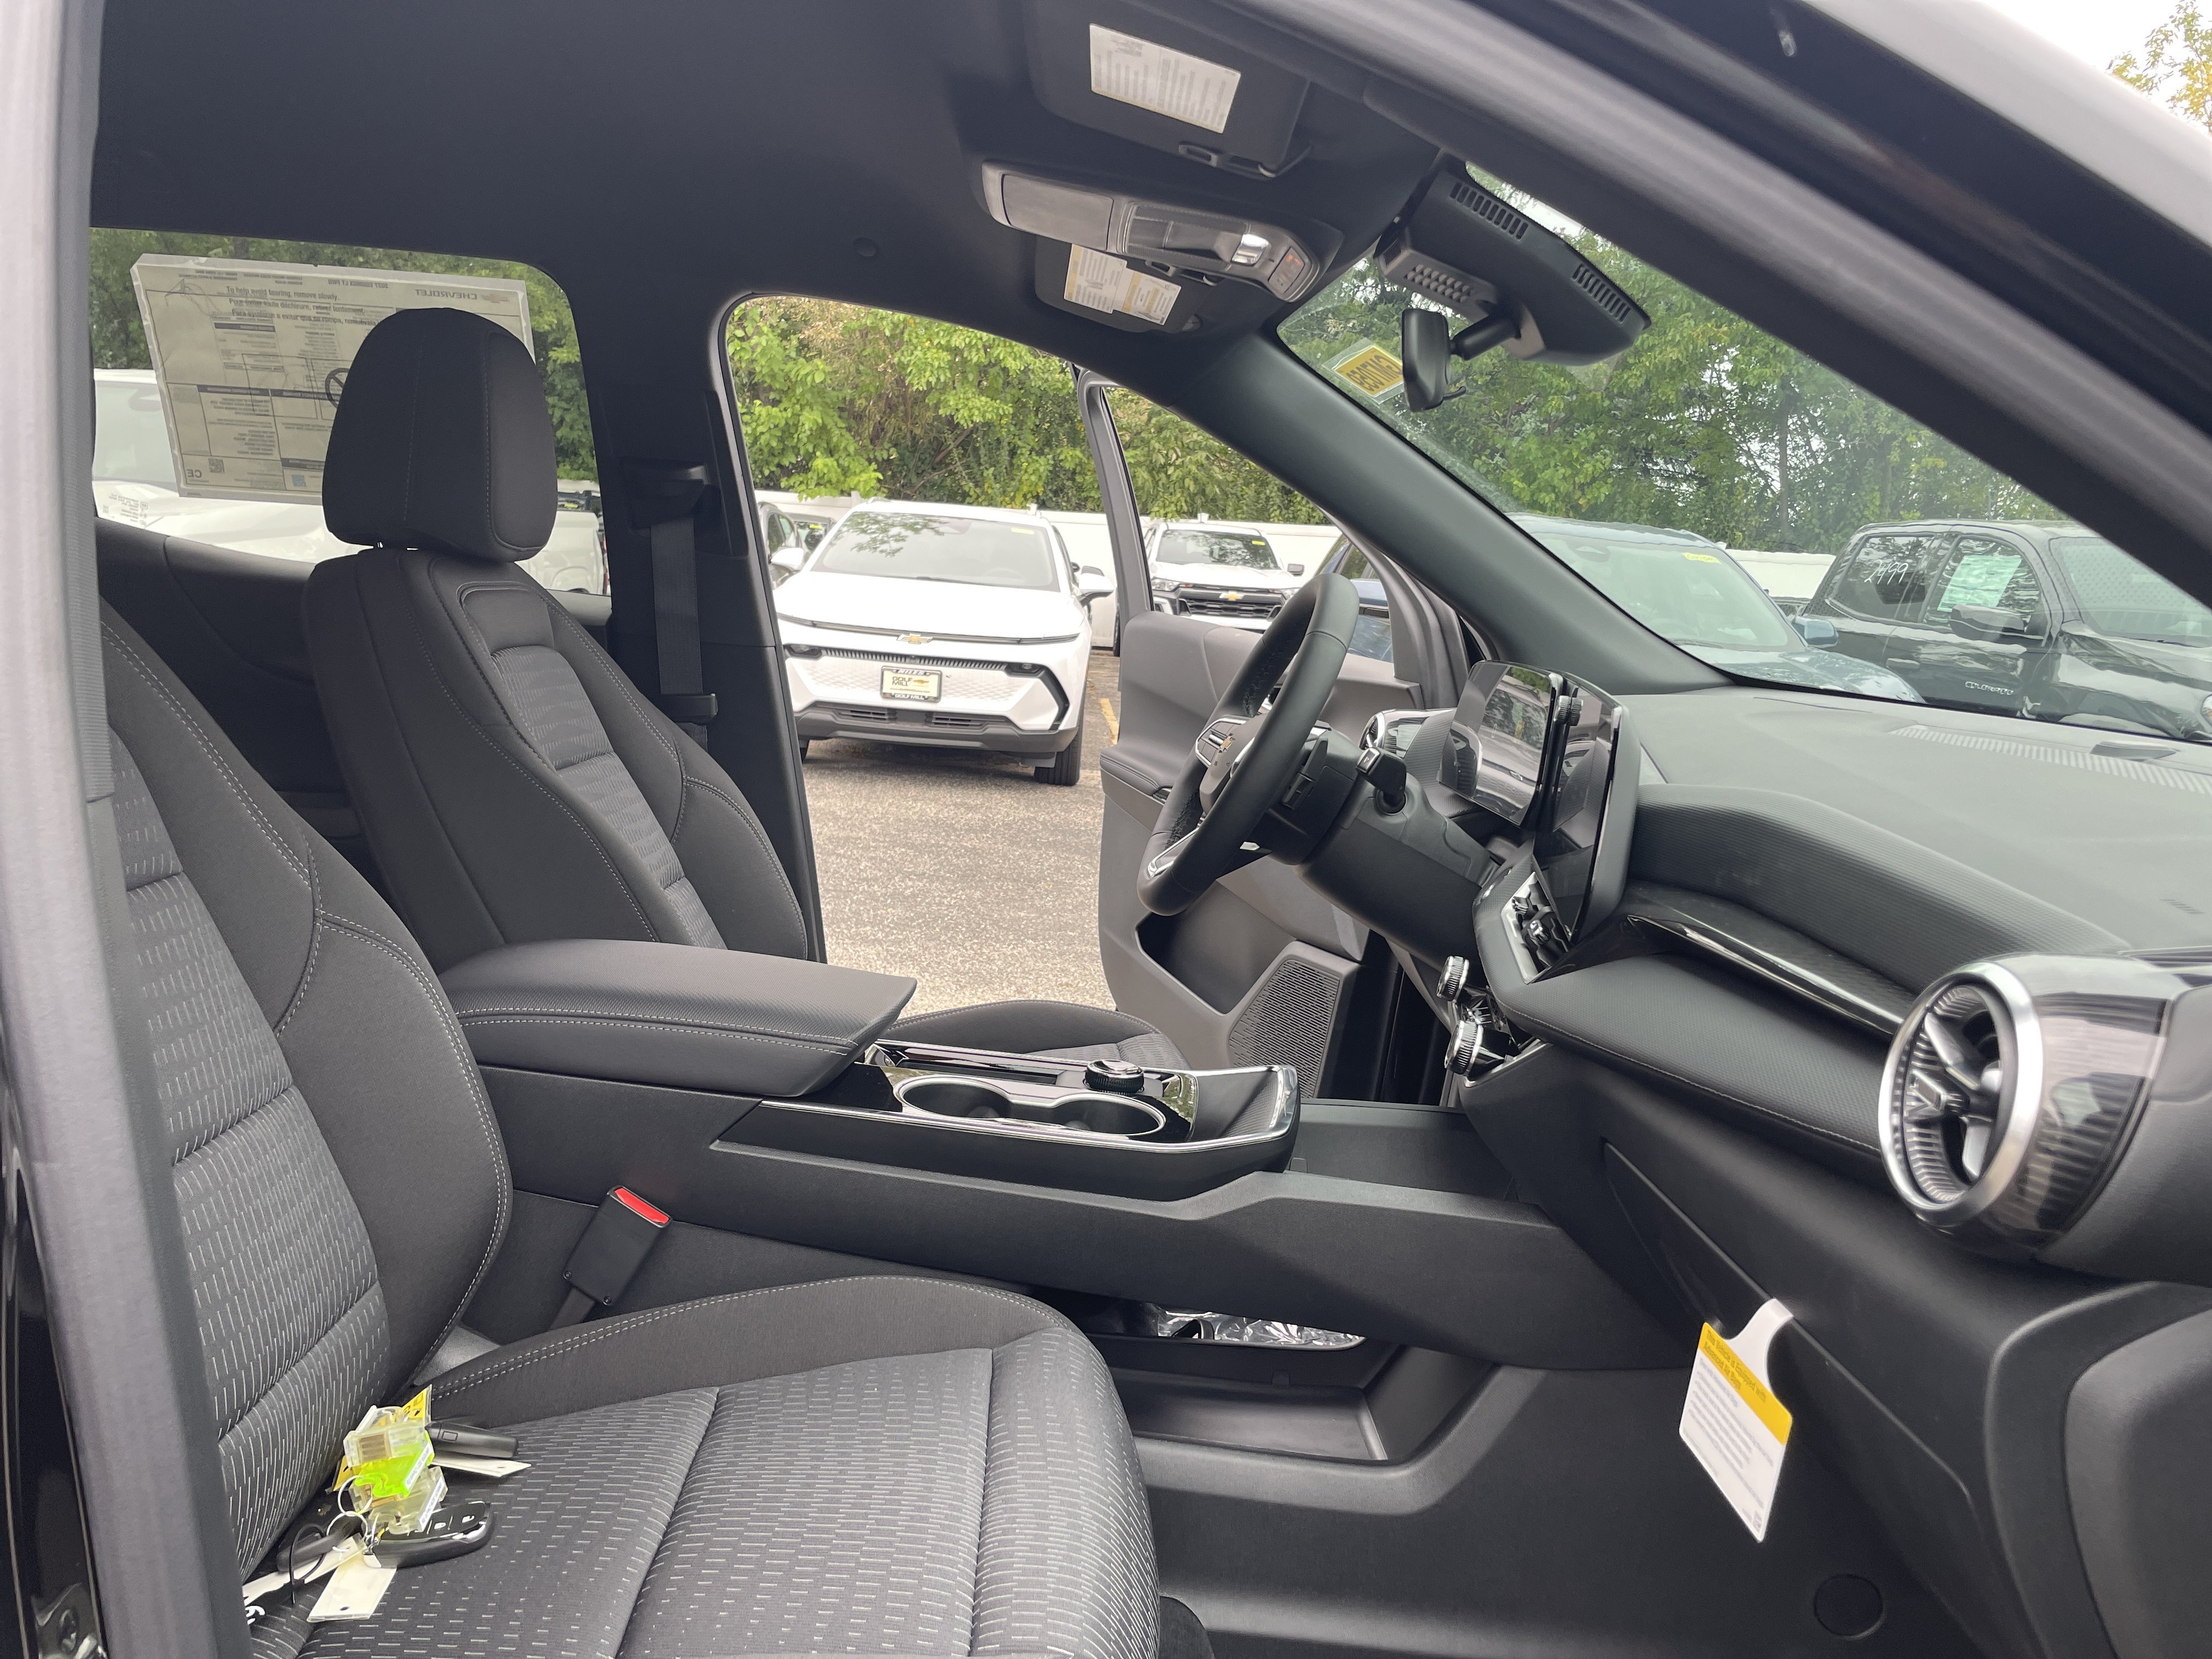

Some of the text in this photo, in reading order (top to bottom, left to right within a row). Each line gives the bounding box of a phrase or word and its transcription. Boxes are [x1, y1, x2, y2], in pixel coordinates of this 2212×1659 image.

[235, 287, 250, 296] help
[268, 289, 292, 298] tearing,
[1706, 1329, 1767, 1403] This Vehicle is Equipped with
